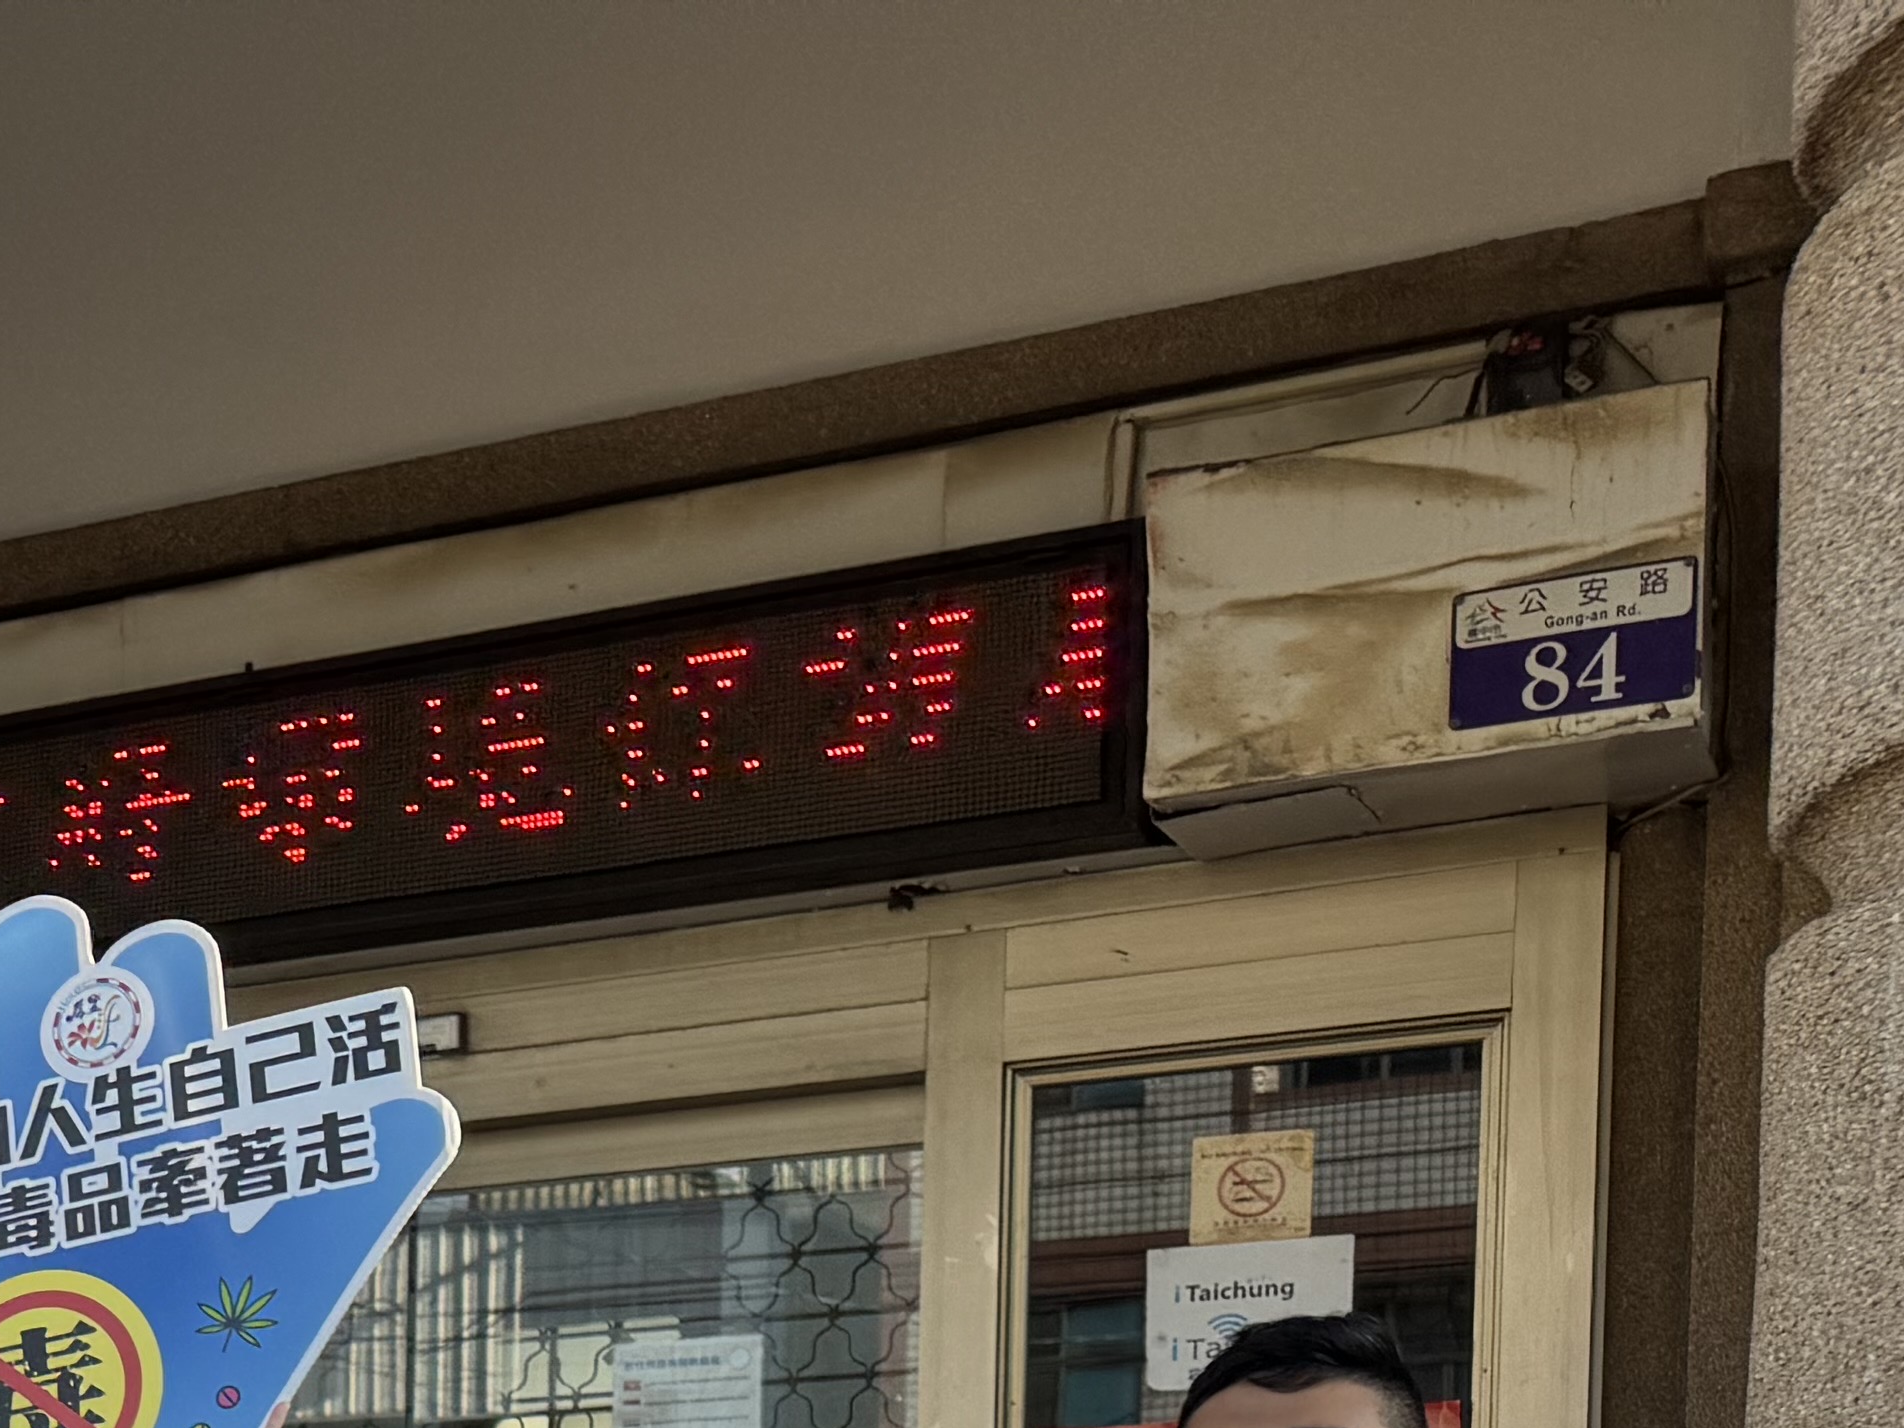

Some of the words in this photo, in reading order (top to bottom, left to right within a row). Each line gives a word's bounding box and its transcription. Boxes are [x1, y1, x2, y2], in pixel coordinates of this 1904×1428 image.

[1519, 567, 1668, 616] 公安路
[1545, 610, 1607, 629] Gong-an
[1617, 604, 1641, 617] Rd.
[1522, 632, 1626, 711] 84
